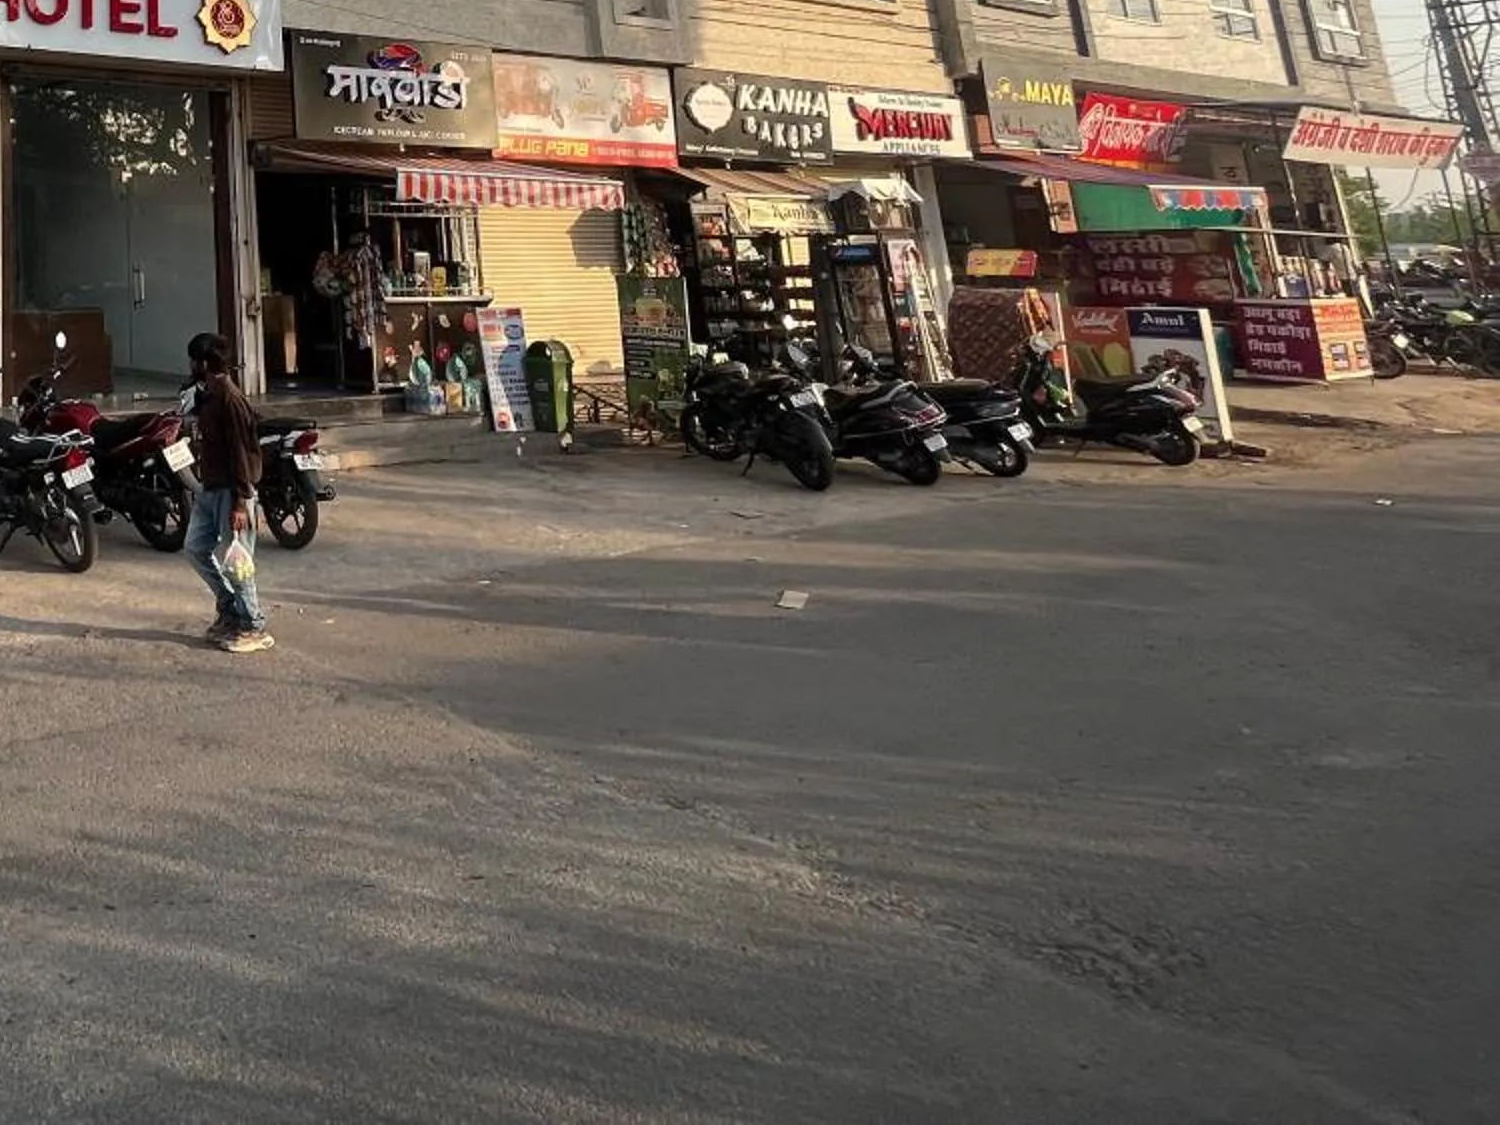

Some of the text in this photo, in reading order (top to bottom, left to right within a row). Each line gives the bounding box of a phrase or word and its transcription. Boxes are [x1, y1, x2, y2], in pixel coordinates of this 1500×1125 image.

[739, 84, 829, 117] KANHA
[1025, 81, 1074, 107] MAYA
[744, 116, 823, 149] BAKERS
[847, 97, 953, 141] MERCURY
[1140, 312, 1185, 326] Amul
